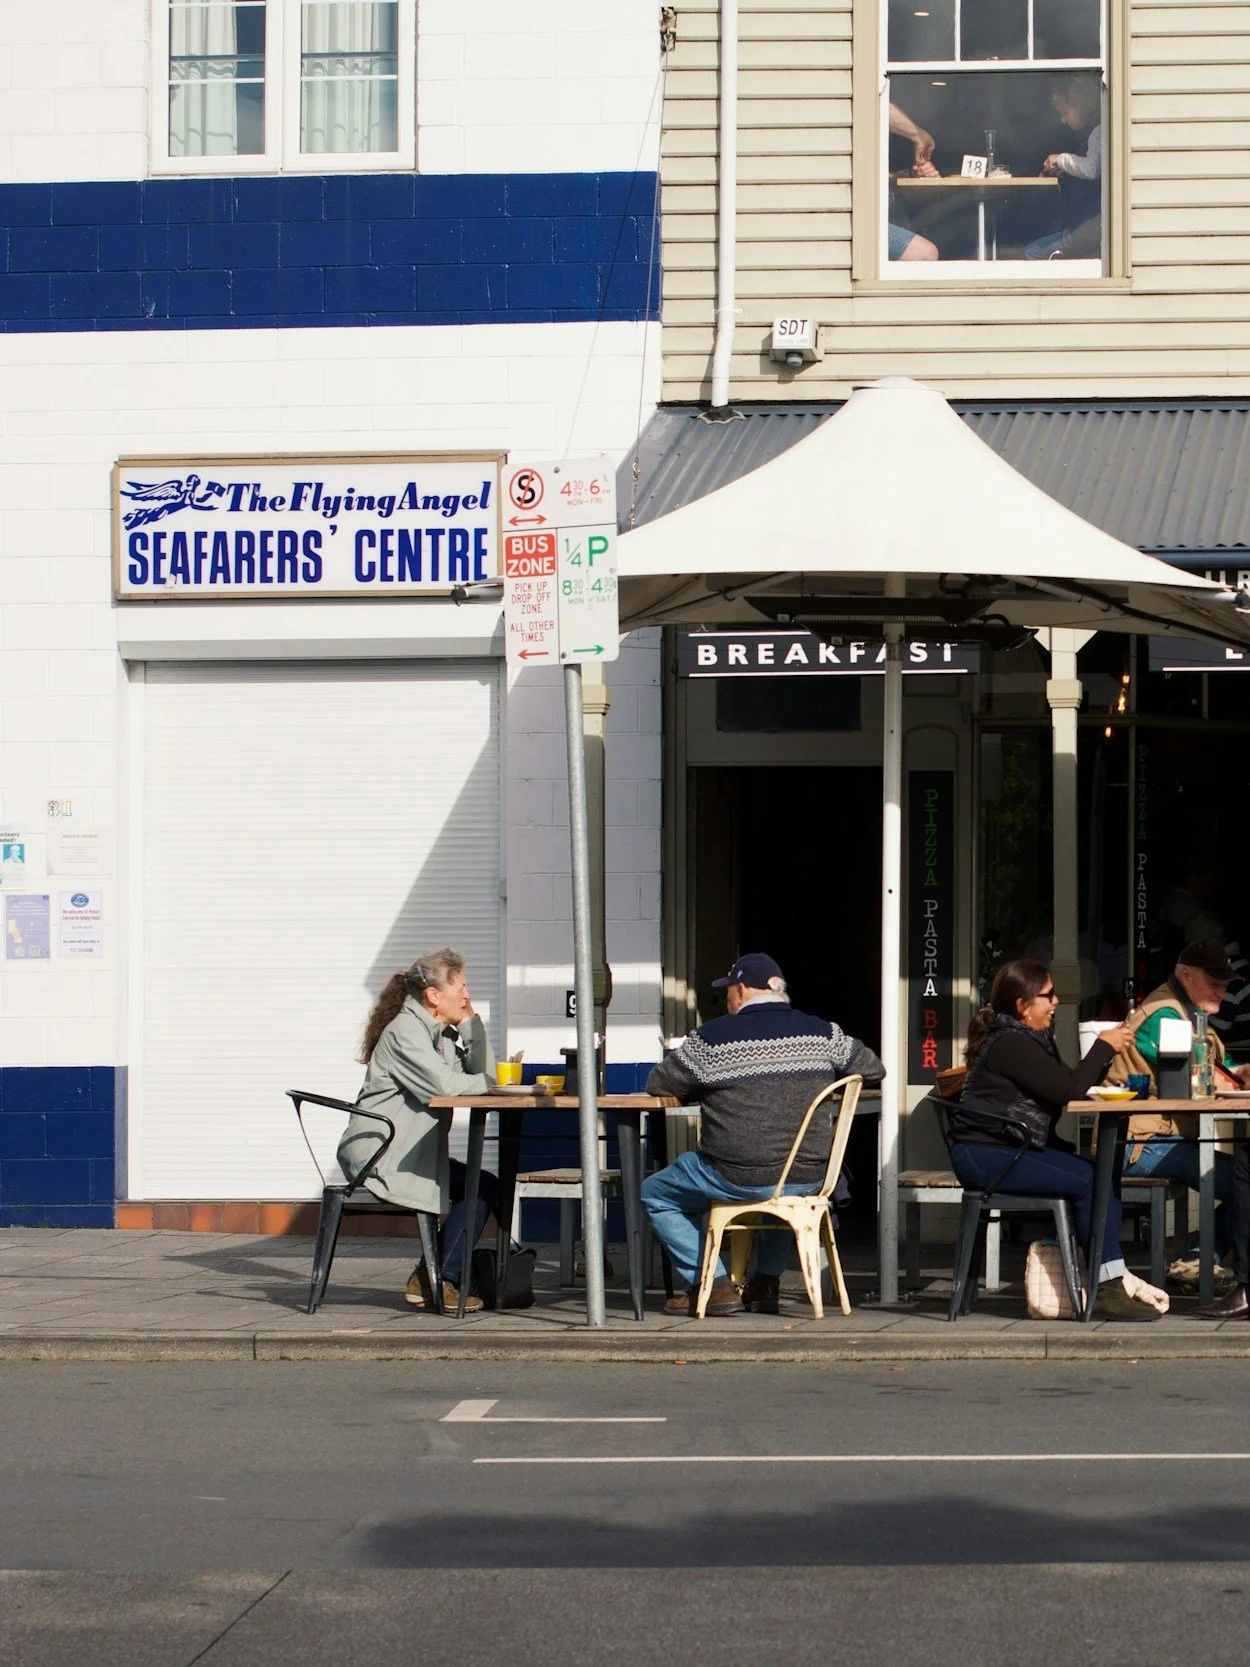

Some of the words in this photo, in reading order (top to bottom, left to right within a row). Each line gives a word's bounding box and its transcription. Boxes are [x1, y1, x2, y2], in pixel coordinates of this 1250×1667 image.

[967, 159, 983, 175] 18
[778, 319, 808, 336] SDT
[226, 481, 287, 513] The
[288, 481, 399, 519] Flying
[397, 481, 492, 518] Angel
[128, 524, 337, 585] SEAFARERS'
[355, 527, 489, 583] CENTRE
[511, 535, 549, 555] BUS
[588, 535, 609, 567] P
[507, 556, 555, 577] ZONE
[514, 582, 533, 592] PICK
[536, 581, 548, 591] UP
[511, 593, 532, 604] DROP
[536, 591, 551, 602] OFF
[521, 603, 542, 614] ZONE
[510, 622, 525, 632] ALL
[529, 620, 555, 631] OTHER
[521, 631, 545, 642] TIMES
[1138, 744, 1149, 840] PIZZA
[923, 789, 938, 886] PIZZA
[1137, 852, 1148, 950] PASTA
[922, 899, 938, 997] PASTA
[922, 1010, 938, 1068] BAR
